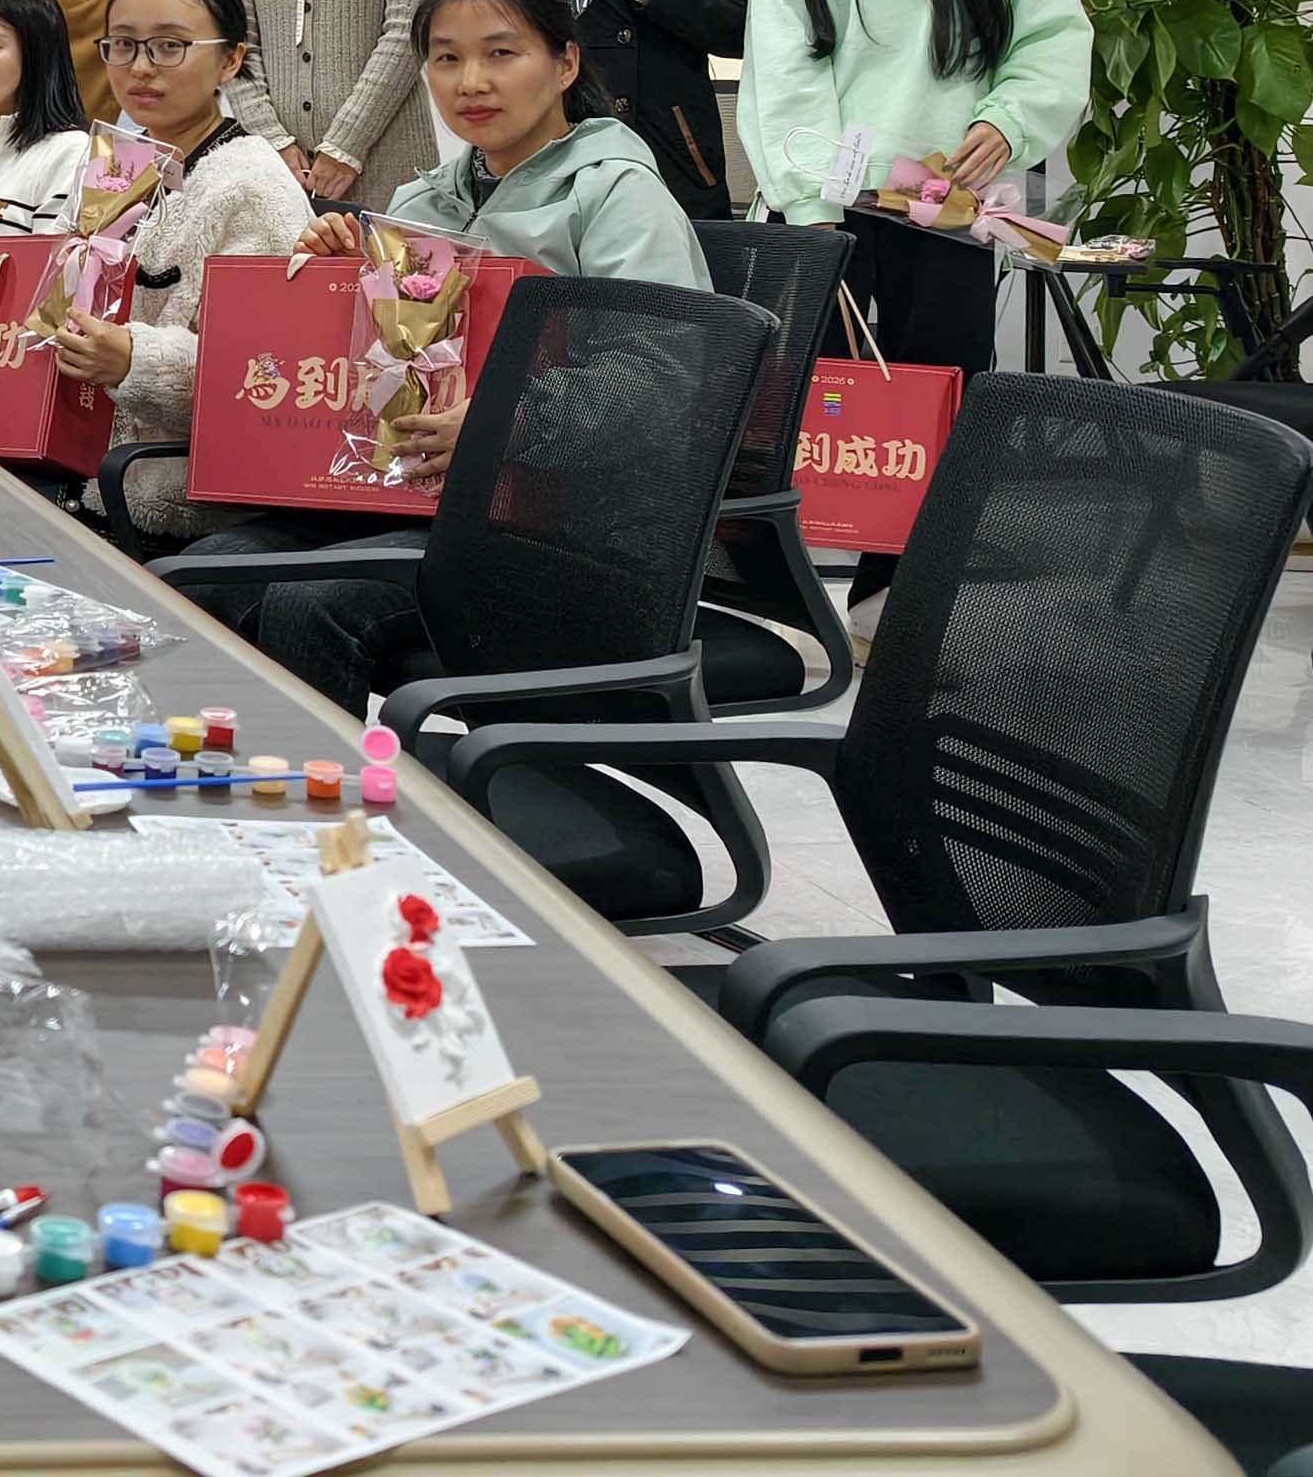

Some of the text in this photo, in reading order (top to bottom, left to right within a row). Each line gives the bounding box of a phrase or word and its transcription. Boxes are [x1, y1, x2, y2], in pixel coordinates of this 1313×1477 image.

[339, 282, 362, 293] 202
[793, 431, 926, 481] 到成功
